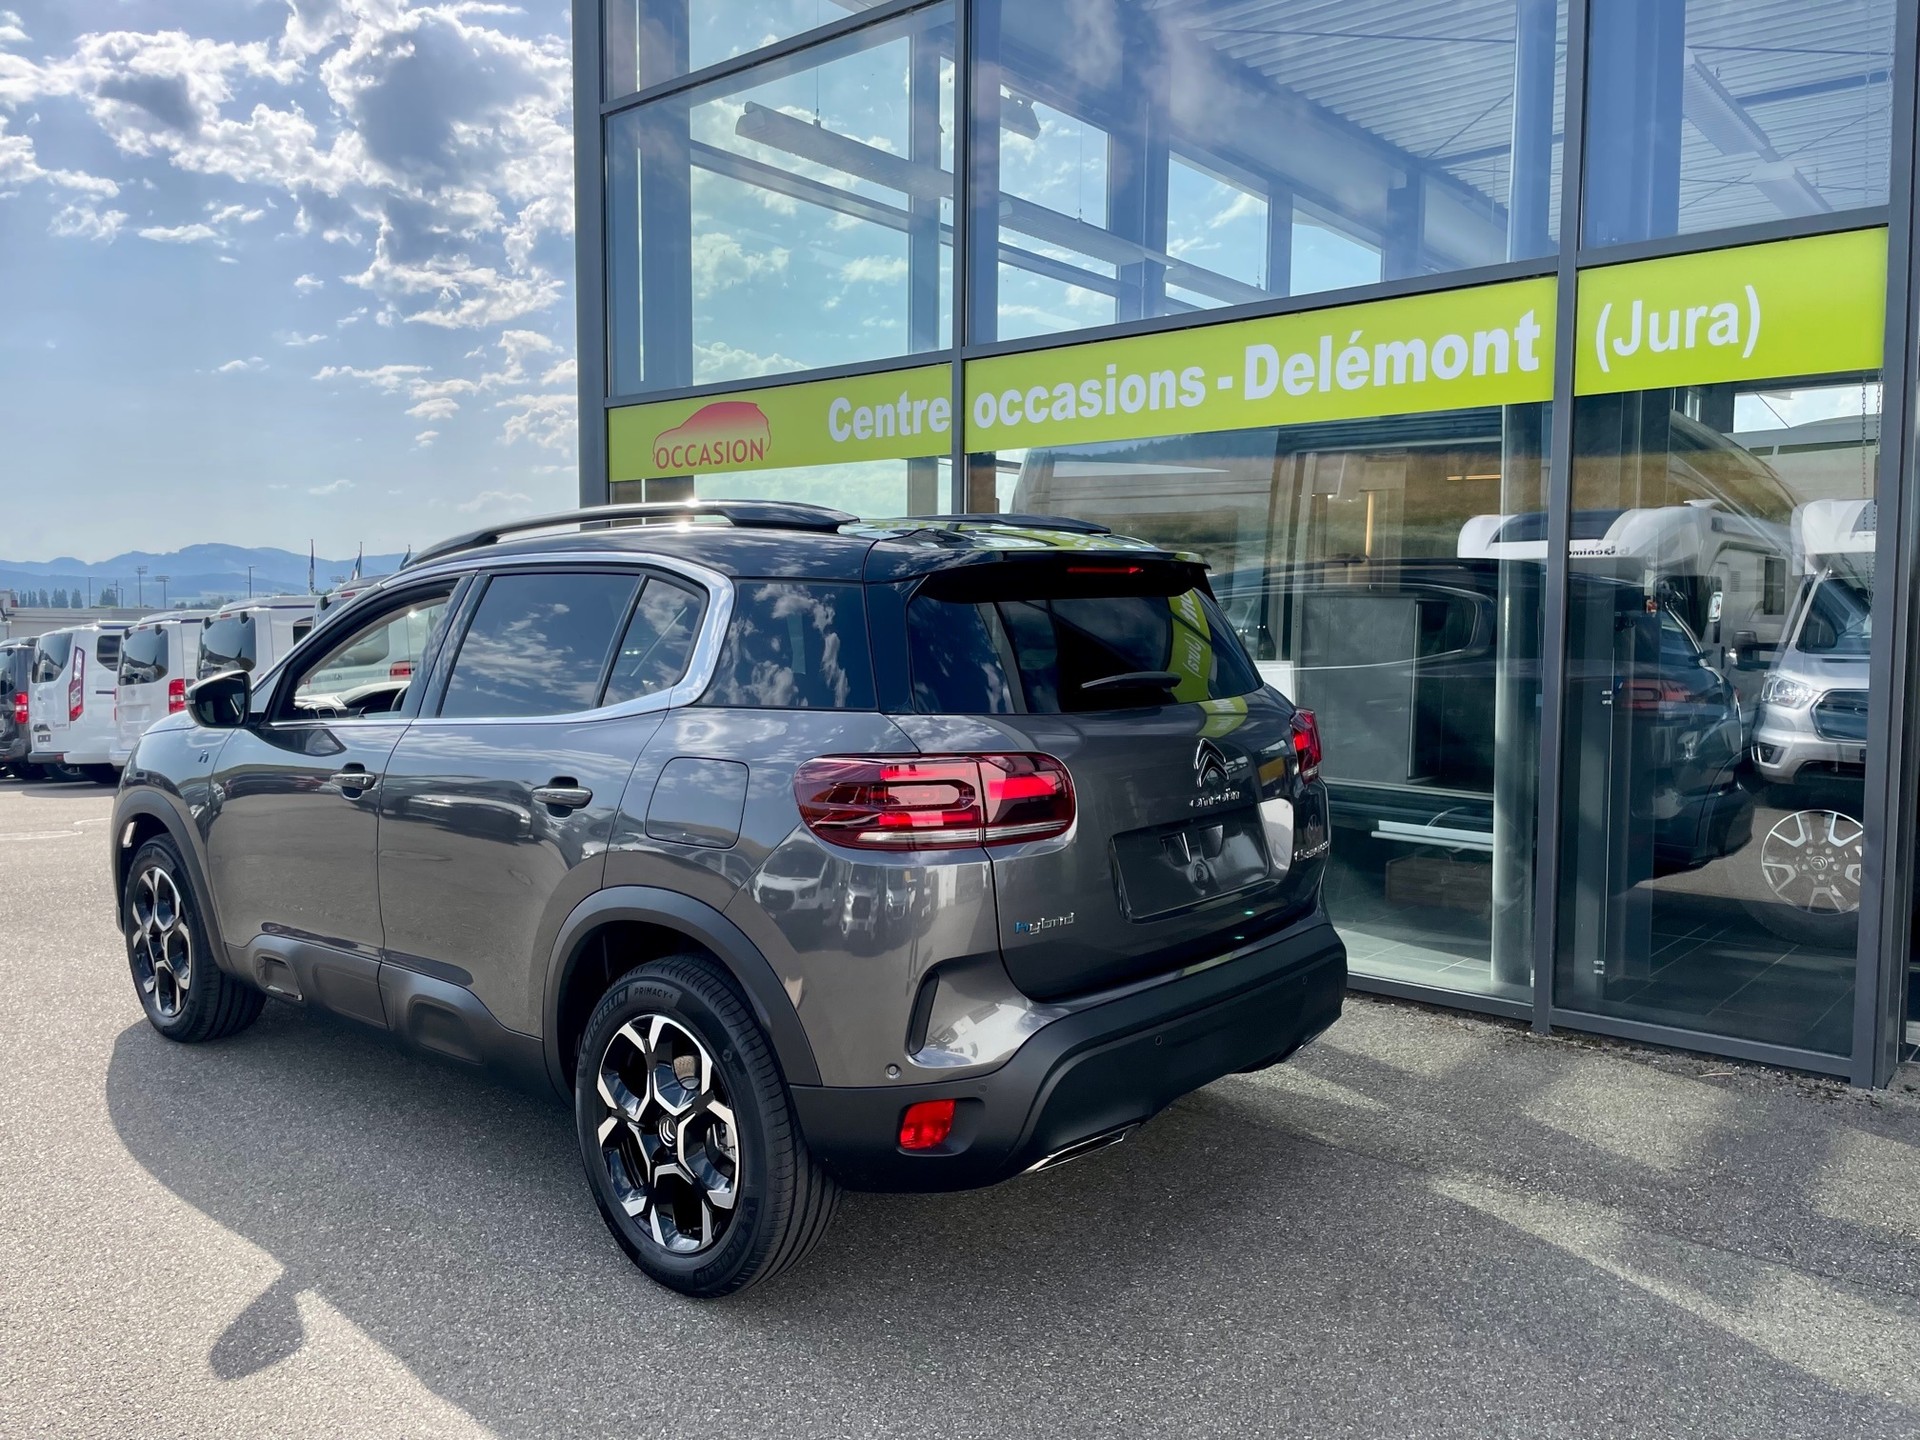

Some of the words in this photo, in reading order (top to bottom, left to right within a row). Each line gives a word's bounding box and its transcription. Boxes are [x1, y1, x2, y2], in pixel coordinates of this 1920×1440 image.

[828, 388, 950, 442] Centre
[973, 364, 1206, 428] occasions
[1244, 309, 1541, 400] Delémont
[1596, 284, 1760, 373] (Jura)
[655, 437, 764, 469] OCCASION
[584, 987, 627, 1050] MICHELIN
[634, 986, 669, 999] PRIMACY
